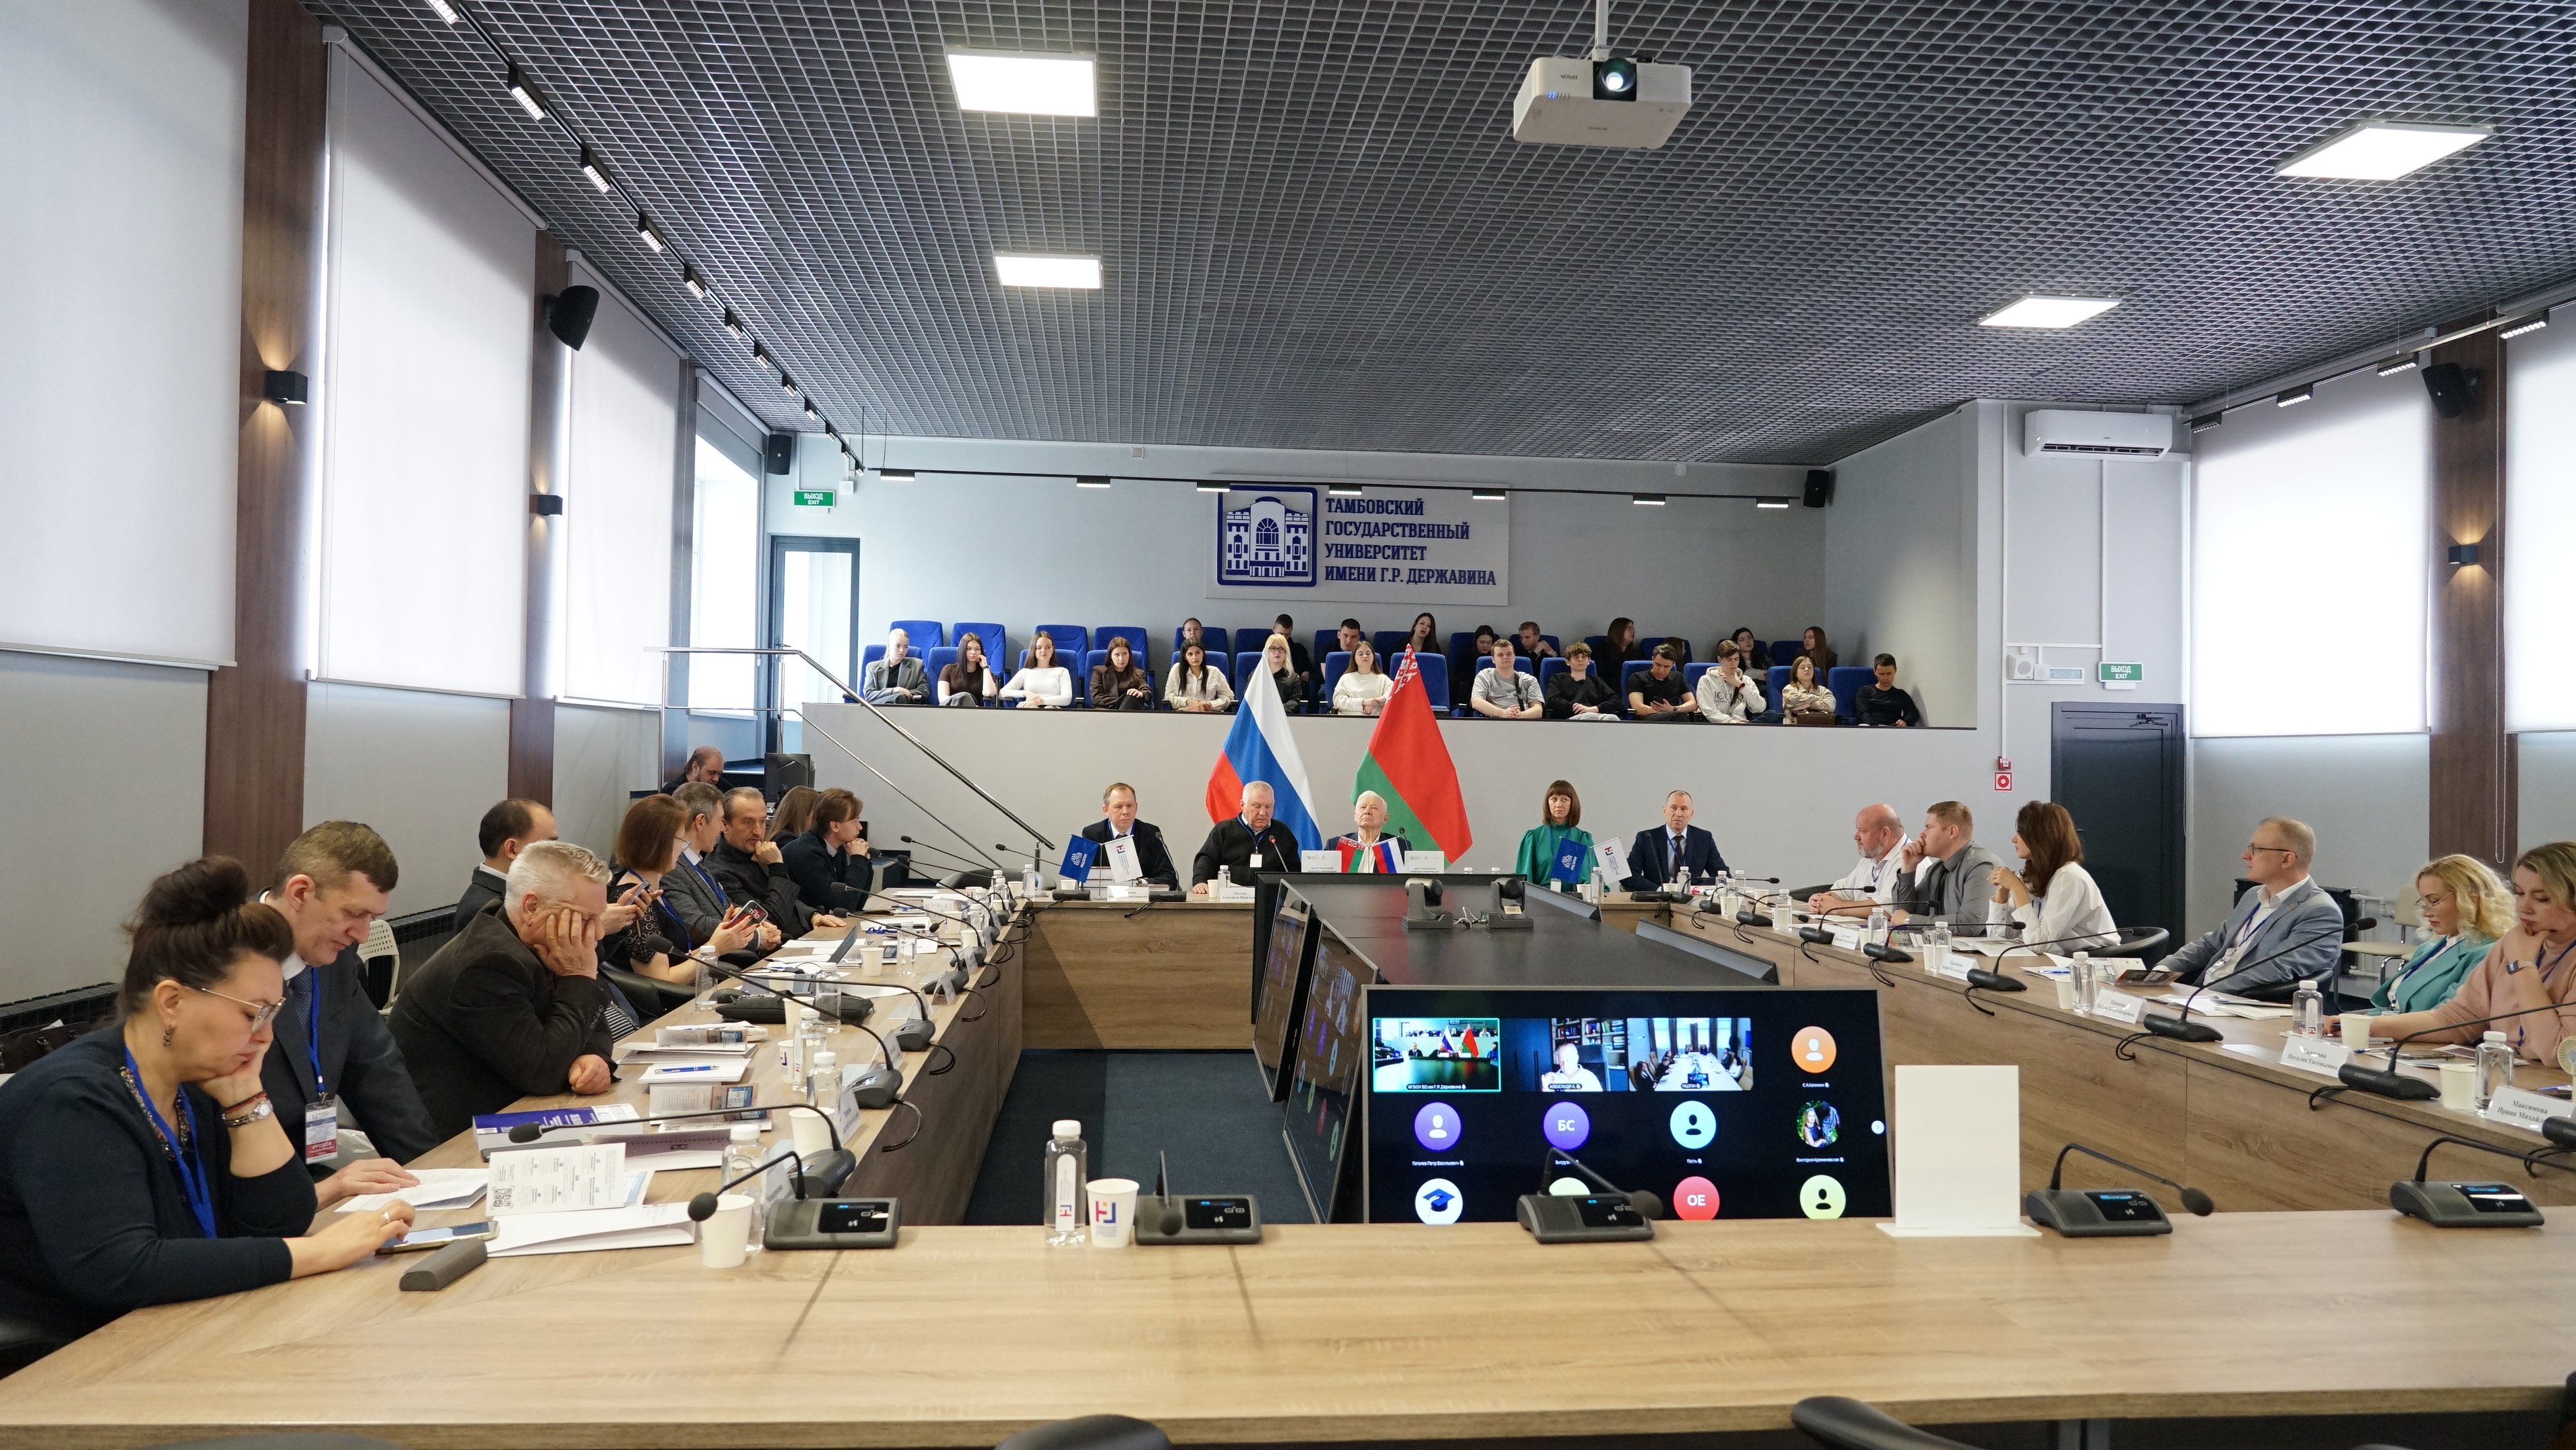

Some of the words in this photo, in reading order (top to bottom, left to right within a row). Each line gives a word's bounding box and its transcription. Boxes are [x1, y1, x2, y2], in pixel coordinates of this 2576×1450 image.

[1325, 497, 1424, 516] ТАМБОВСКИЙ
[1325, 521, 1471, 540] ГОСУДАРСТВЕННЫЙ
[1324, 543, 1427, 561] УНИВЕРСИТЕТ
[1324, 565, 1376, 582] ИМЕНИ
[1380, 567, 1404, 584] Г.Р.
[1406, 568, 1497, 586] ДЕРЖАВИНА
[749, 908, 760, 919] 11:10
[2308, 1058, 2338, 1070] Евгеньевна
[2497, 1106, 2517, 1117] Ирина
[2512, 1100, 2549, 1114] Максимова
[1558, 1120, 1575, 1131] БС
